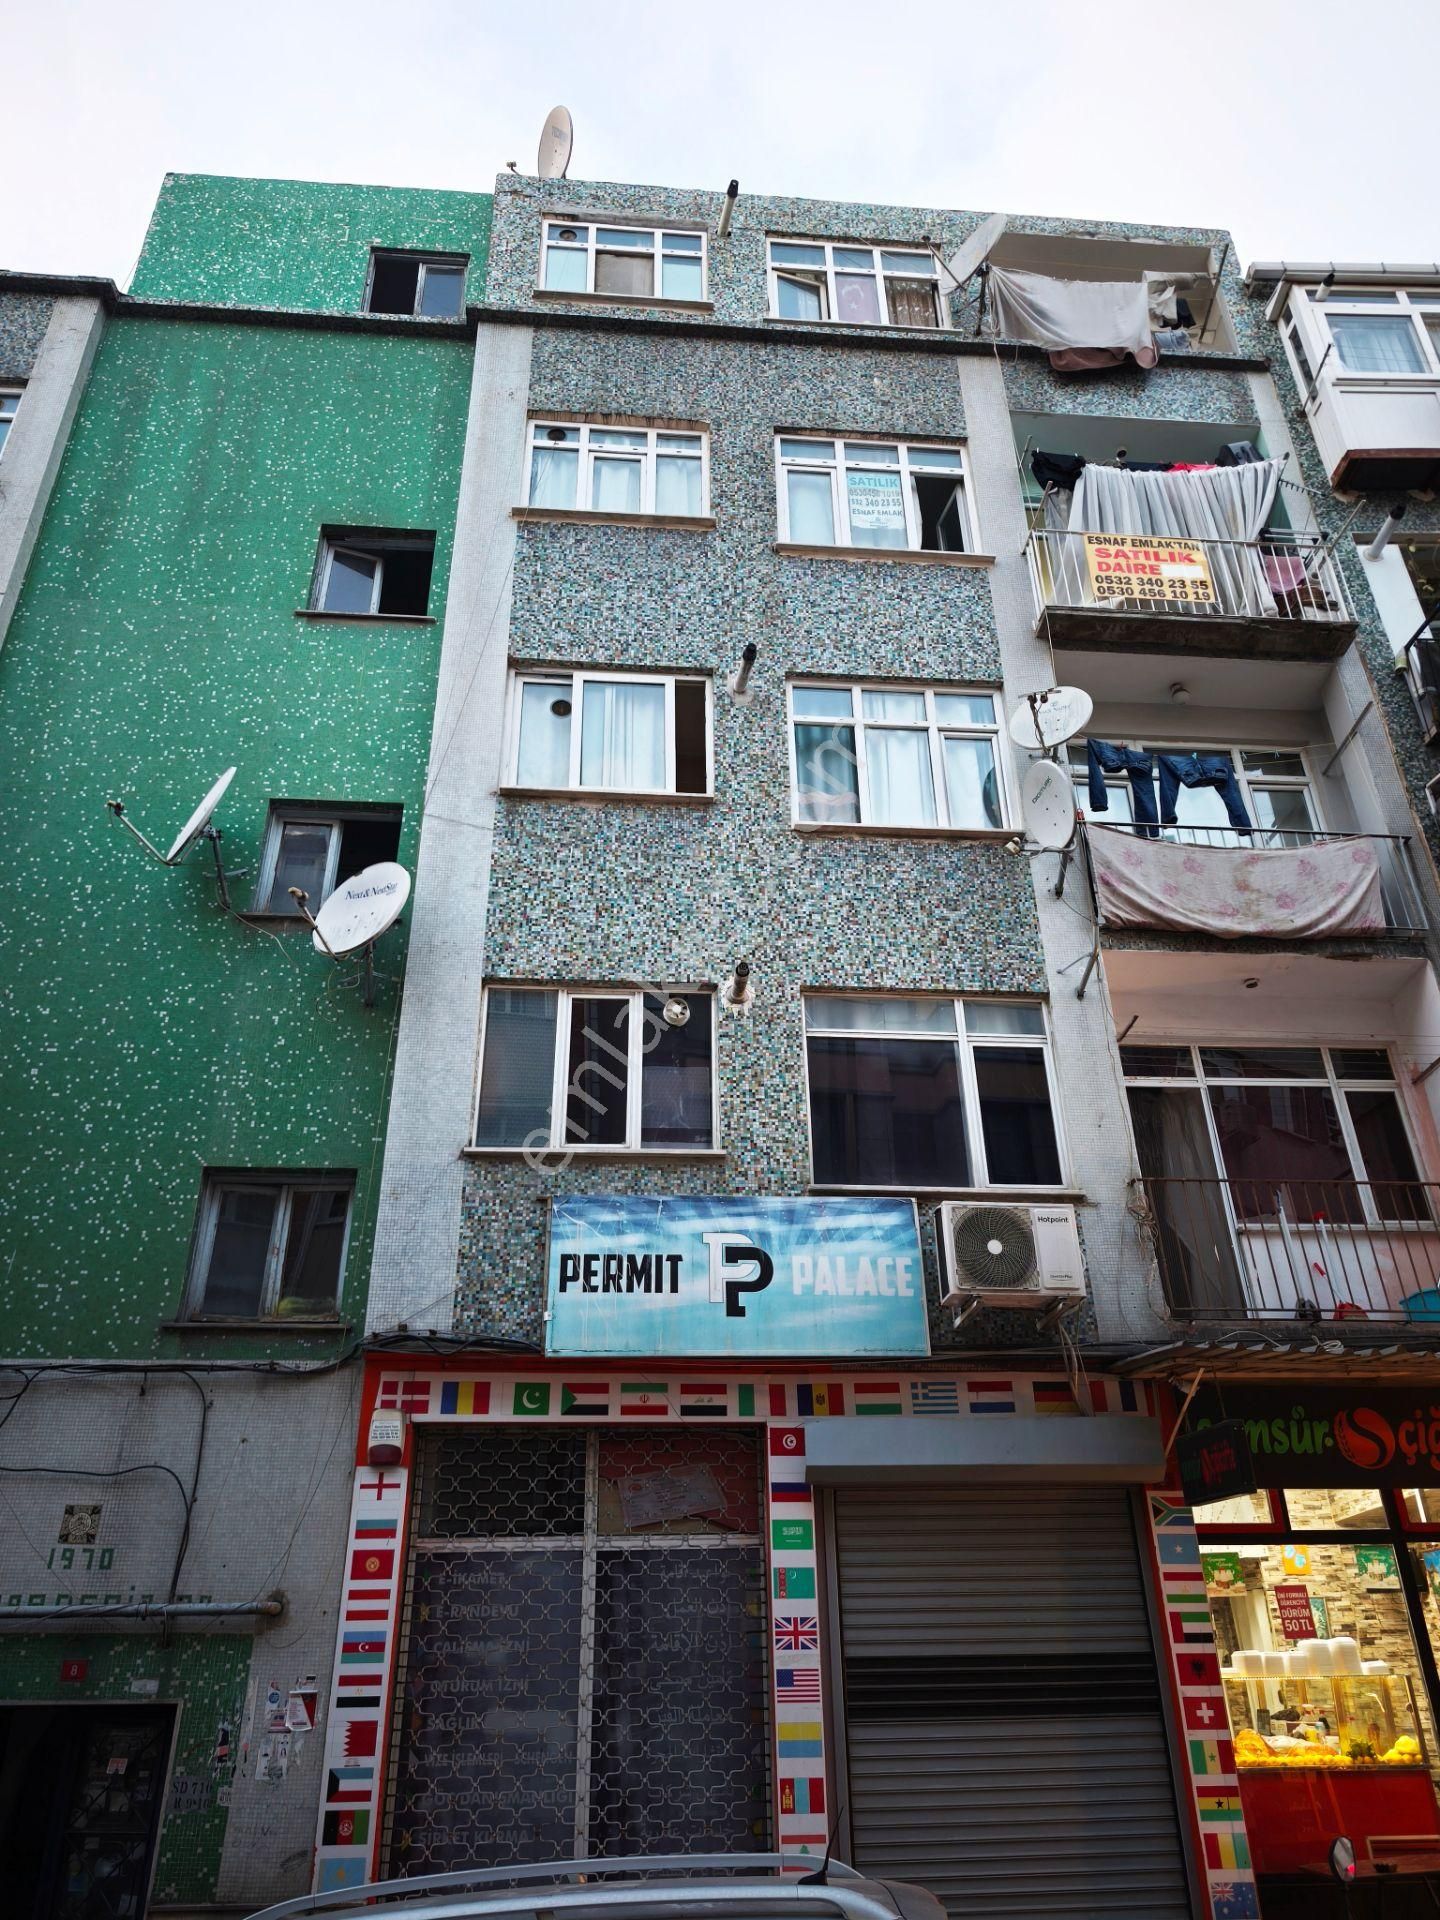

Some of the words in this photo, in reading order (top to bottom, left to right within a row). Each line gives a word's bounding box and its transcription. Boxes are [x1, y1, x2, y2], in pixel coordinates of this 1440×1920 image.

[849, 477, 898, 488] SATILIK
[1087, 535, 1127, 546] ESNAF
[1131, 538, 1200, 552] EMLAK'TAN
[1094, 547, 1197, 564] SATILIK
[1096, 560, 1162, 576] DAİRE
[1095, 574, 1133, 586] 0532
[1136, 577, 1164, 588] 340
[1168, 579, 1187, 590] 23
[1190, 580, 1209, 591] 55
[1097, 585, 1134, 597] 0530
[1139, 588, 1166, 598] 456
[1170, 590, 1189, 600] 10
[1193, 591, 1211, 602] 19
[1037, 1215, 1070, 1225] Hotpoint
[559, 1253, 684, 1294] PERMIT
[791, 1255, 915, 1298] PALACE
[47, 1547, 115, 1570] 1970
[1281, 1606, 1310, 1618] DÜRÜM
[1284, 1619, 1300, 1632] 50
[1299, 1619, 1314, 1631] TL
[70, 1664, 78, 1677] 8
[430, 1679, 492, 1693] OTURUM
